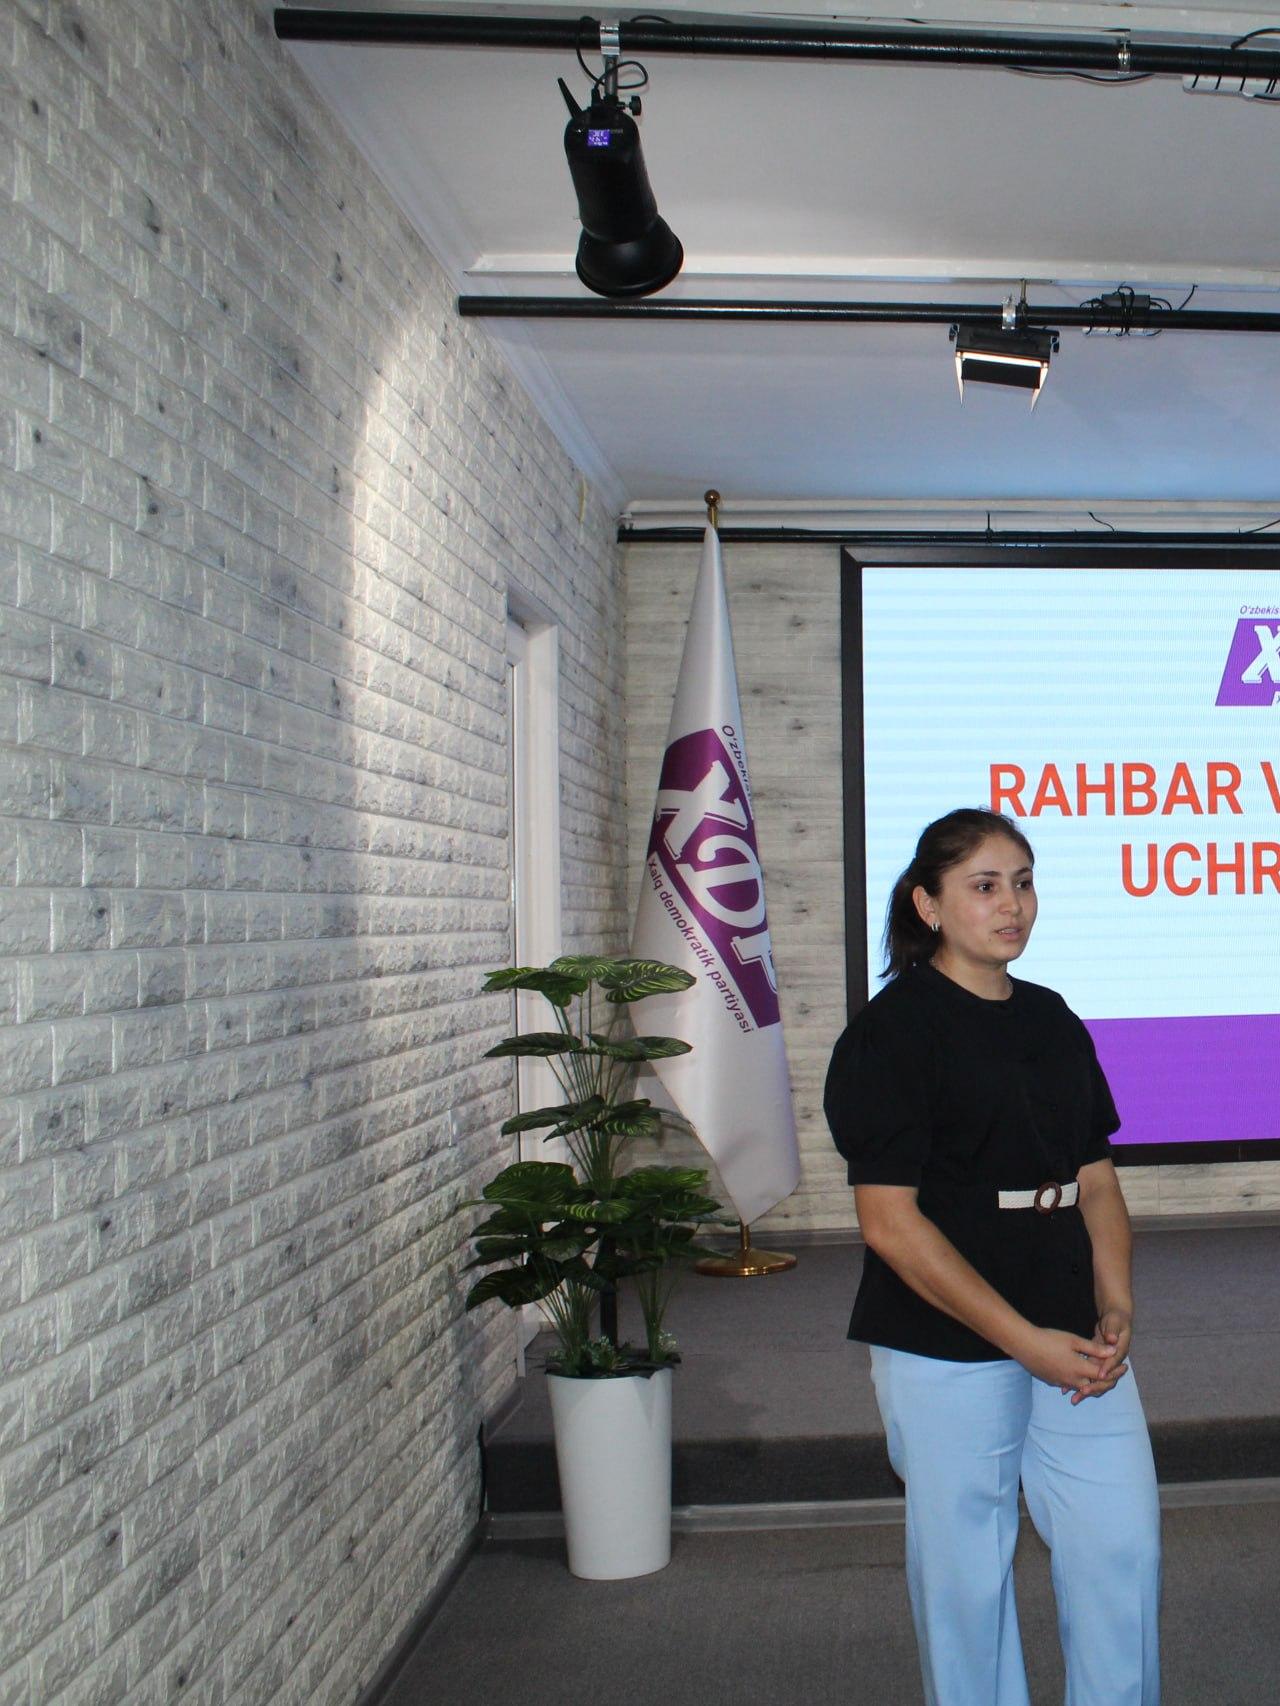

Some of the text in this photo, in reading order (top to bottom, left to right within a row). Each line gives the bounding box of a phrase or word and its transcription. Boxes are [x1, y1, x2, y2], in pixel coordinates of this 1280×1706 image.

[989, 762, 1244, 817] RAHBAR
[660, 890, 716, 968] demokratik
[706, 969, 754, 1034] partiyasi
